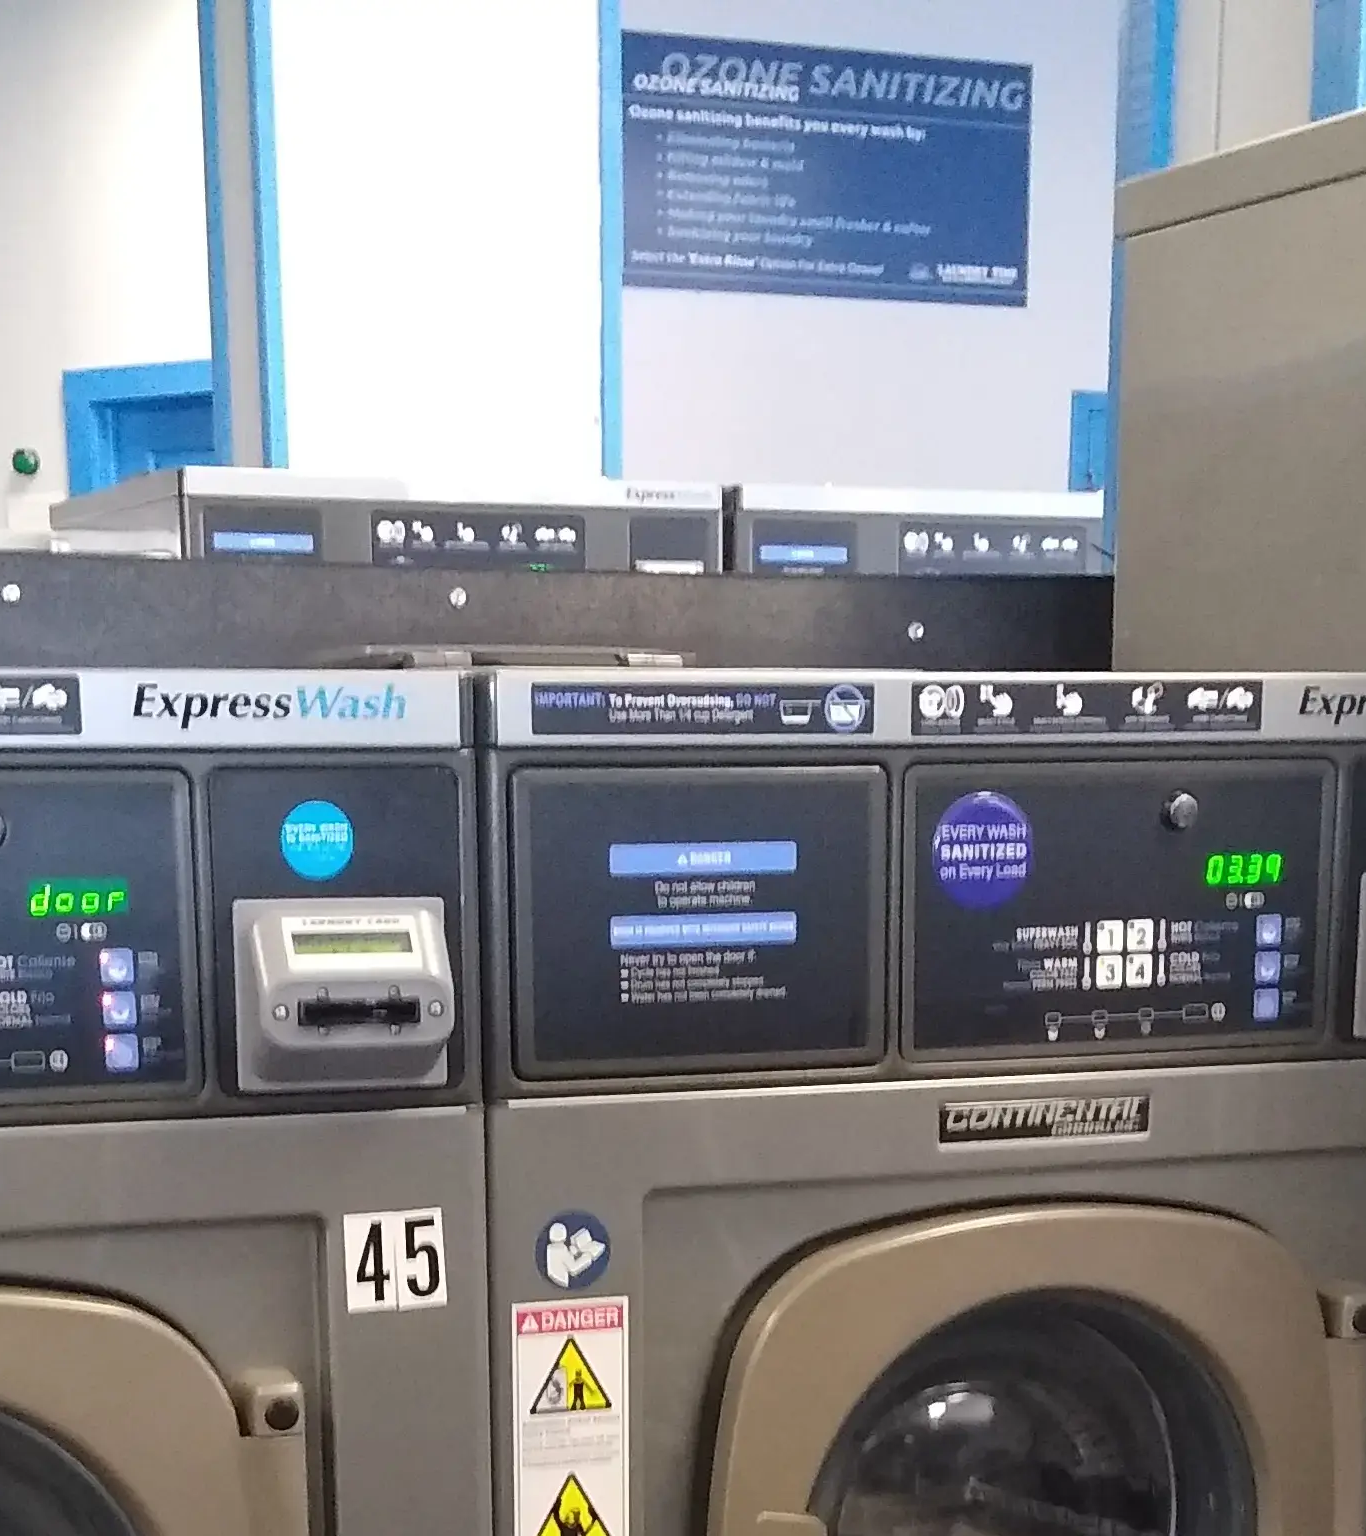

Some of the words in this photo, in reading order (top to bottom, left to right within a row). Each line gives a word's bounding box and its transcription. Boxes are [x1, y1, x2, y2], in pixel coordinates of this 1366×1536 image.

[633, 73, 696, 93] OZONE
[699, 77, 801, 103] SANITIZING
[661, 52, 803, 88] OZONE
[809, 63, 1026, 111] SANITIZING
[609, 693, 623, 708] To
[941, 822, 986, 841] EVERY
[986, 822, 1028, 841] WASH
[939, 842, 1028, 861] SANITIZED
[939, 865, 957, 882] on
[958, 862, 994, 883] Every
[995, 861, 1028, 880] Load
[30, 883, 126, 918] door
[1015, 925, 1079, 943] SUPERWASH
[1136, 926, 1147, 946] 2
[1171, 920, 1193, 934] HOT
[1043, 956, 1078, 973] WARM
[1169, 950, 1201, 966] COLD
[1105, 963, 1116, 982] 3
[1135, 961, 1145, 981] 4
[945, 1096, 1147, 1133] CONTINENTAL
[356, 1215, 440, 1302] 45
[540, 1306, 620, 1332] DANGER
